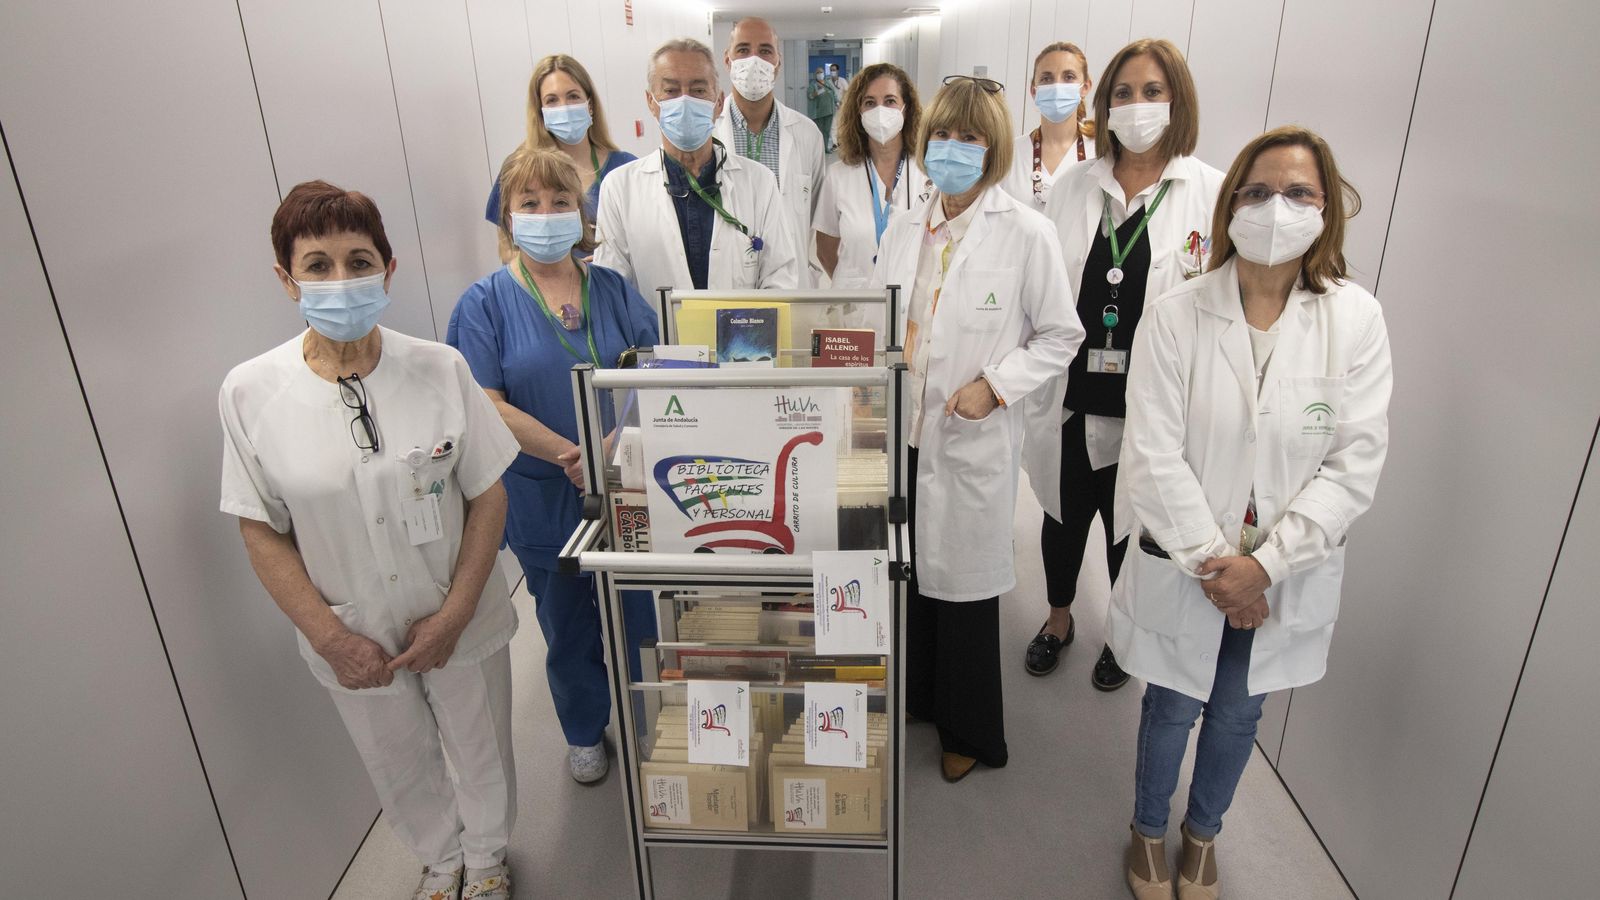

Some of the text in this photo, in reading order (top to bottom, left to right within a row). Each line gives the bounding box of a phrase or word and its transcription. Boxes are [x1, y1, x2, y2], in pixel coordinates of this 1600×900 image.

[825, 344, 859, 352] ALLENDE
[677, 464, 770, 475] BIBLIOTECA
[791, 456, 799, 490] CULTURA
[685, 484, 764, 495] PACIENTES
[792, 492, 799, 501] DE
[693, 508, 773, 519] Y PERSONAL
[633, 511, 649, 552] CALL
